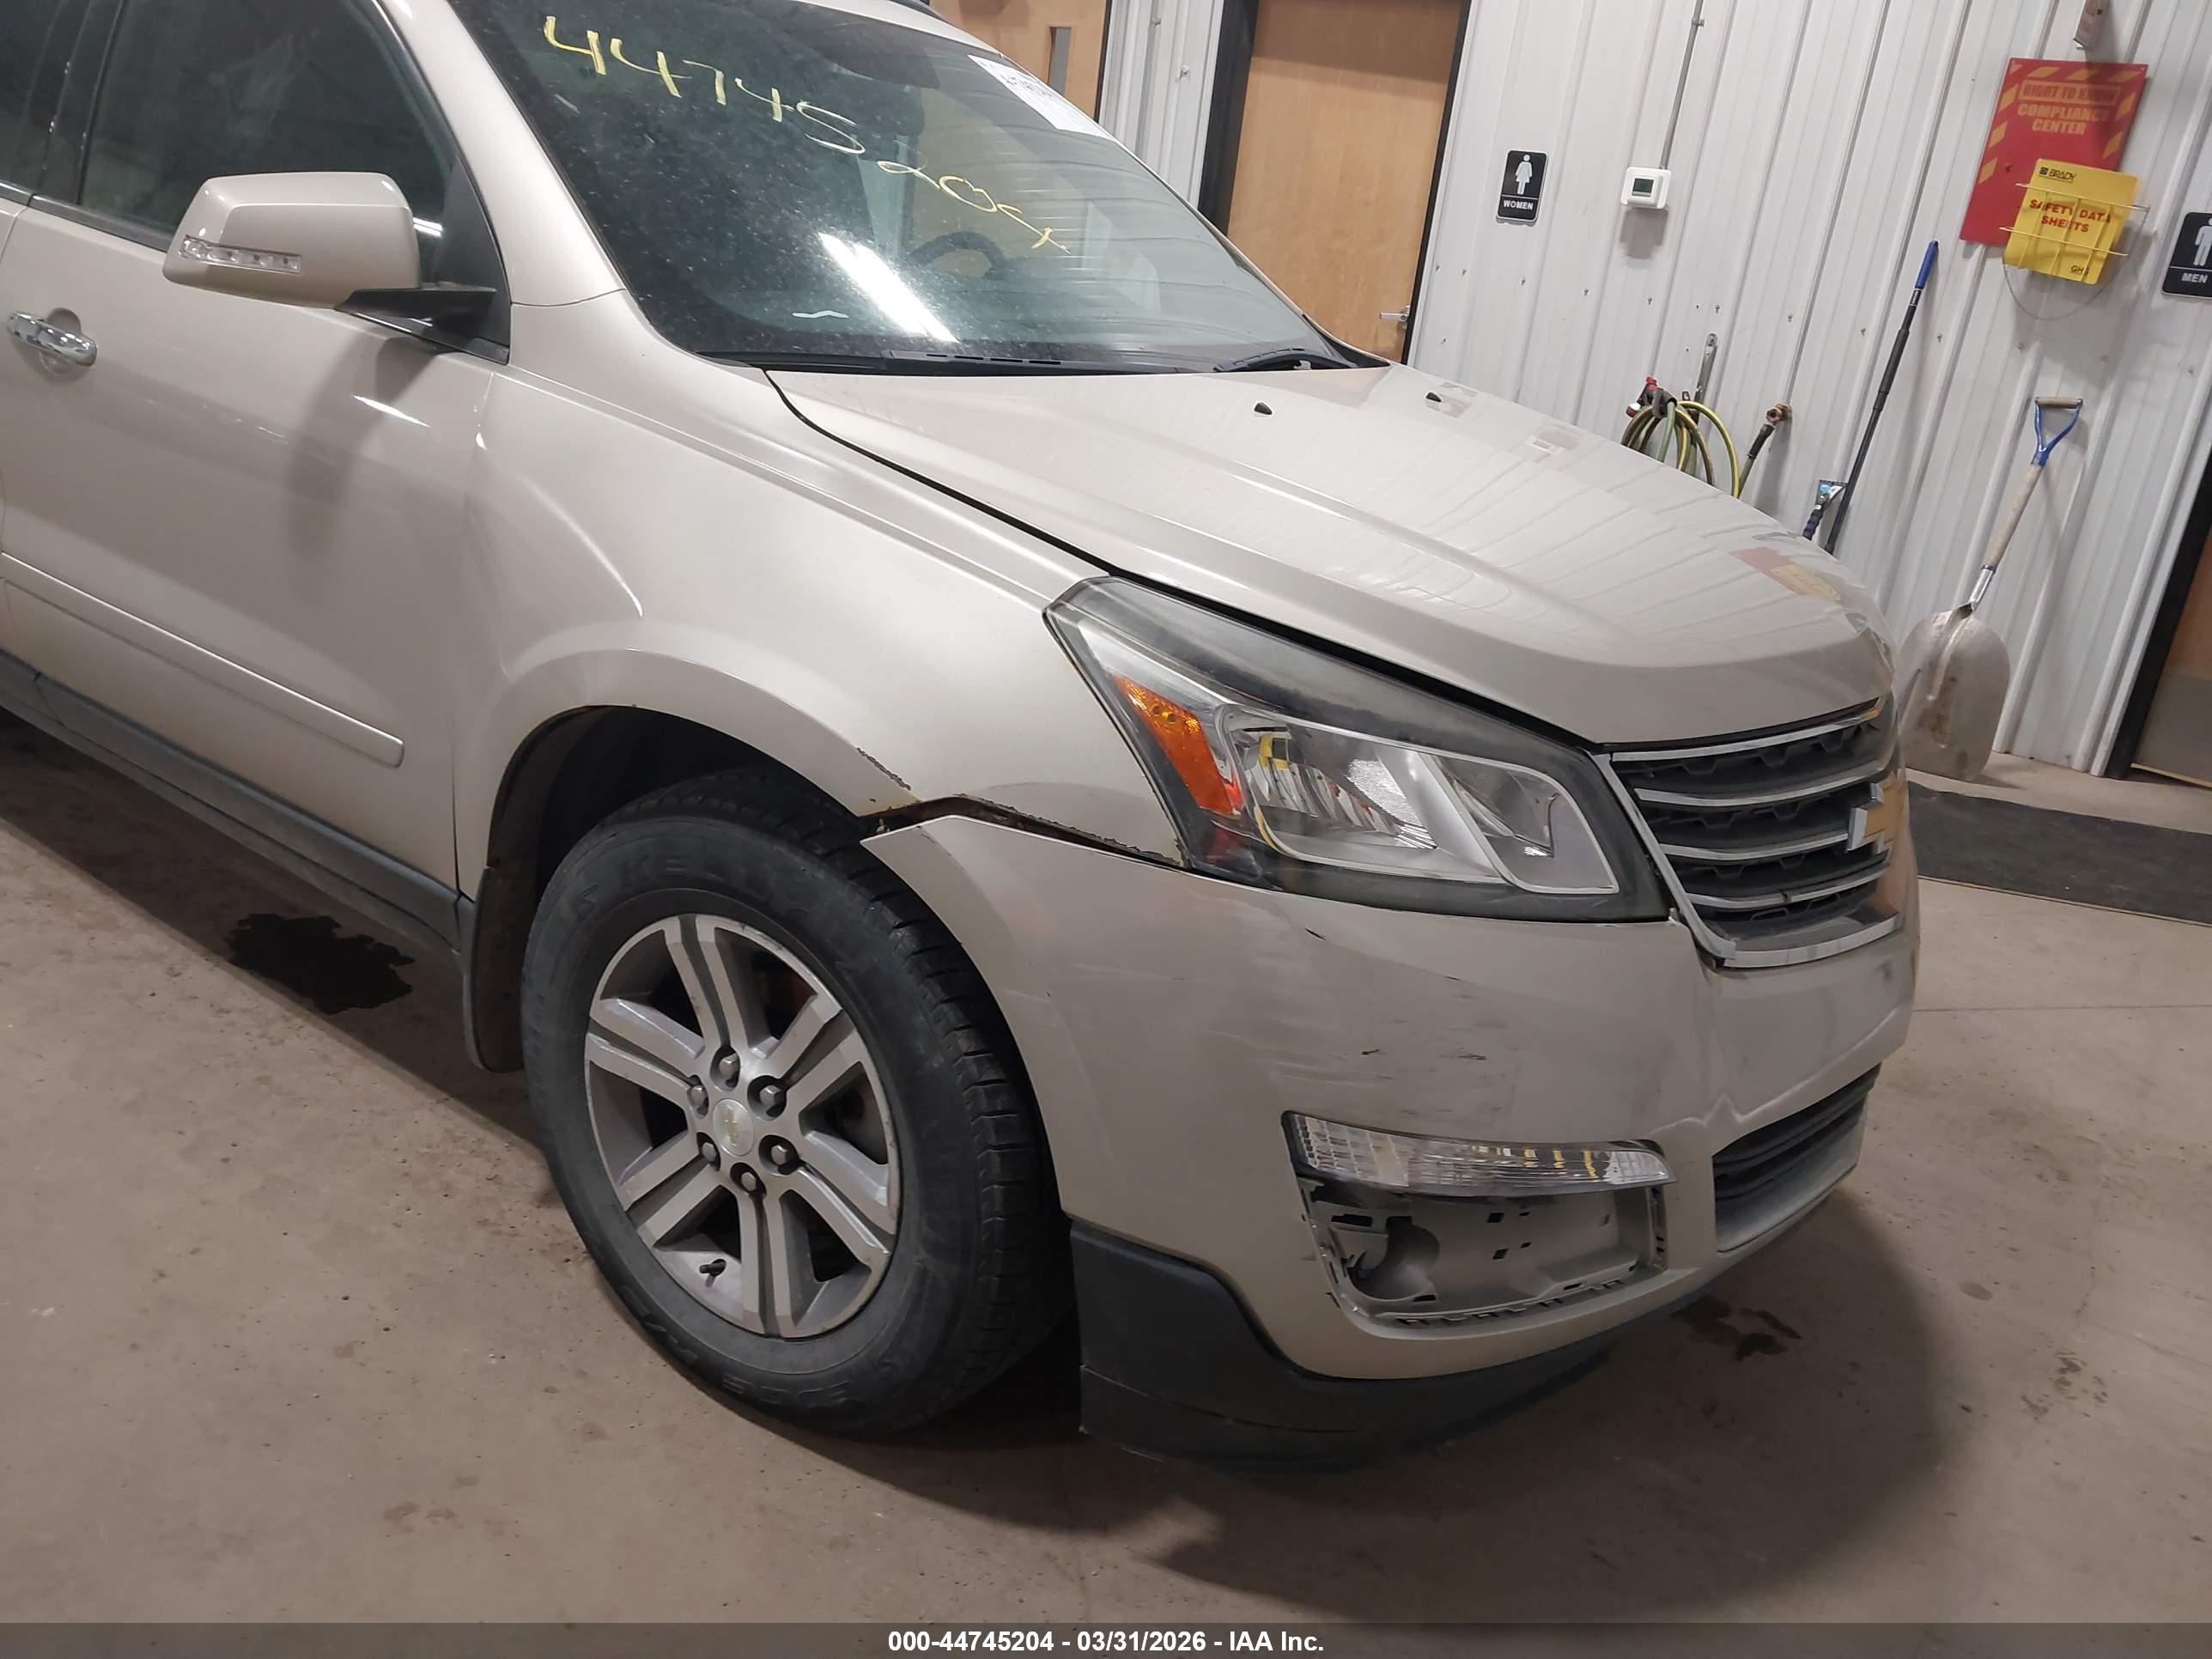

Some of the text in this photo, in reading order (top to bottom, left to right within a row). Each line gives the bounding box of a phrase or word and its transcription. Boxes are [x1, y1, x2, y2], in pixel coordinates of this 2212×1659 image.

[2017, 103, 2112, 122] COMPLIANCE
[2032, 118, 2087, 135] CENTER
[2049, 168, 2077, 180] BRADY
[1503, 199, 1534, 210] WOMEN
[2079, 210, 2112, 223] DATA
[2181, 272, 2209, 283] MEN
